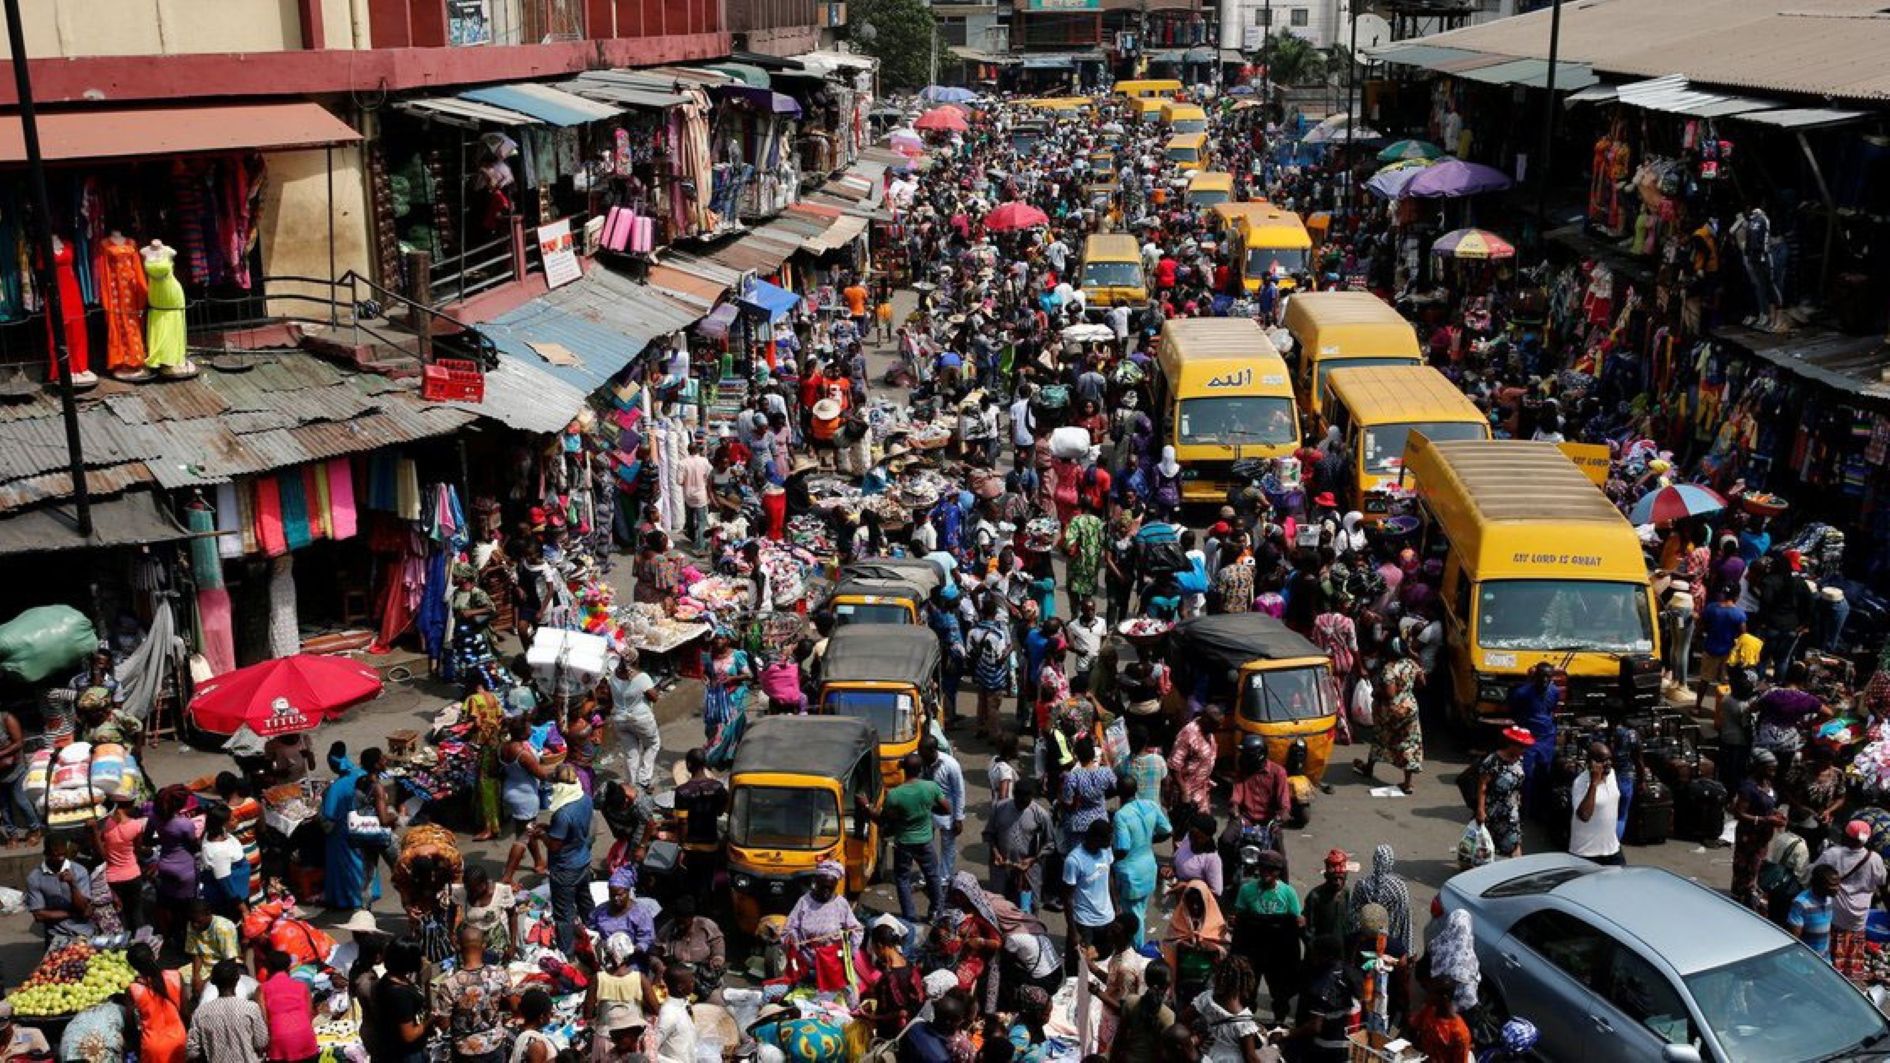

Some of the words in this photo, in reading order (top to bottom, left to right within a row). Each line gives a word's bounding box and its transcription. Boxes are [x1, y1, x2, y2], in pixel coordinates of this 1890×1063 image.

[1531, 553, 1556, 564] LORD
[1559, 554, 1570, 564] IS
[1571, 555, 1603, 567] GREAT
[263, 713, 308, 729] TITUS
